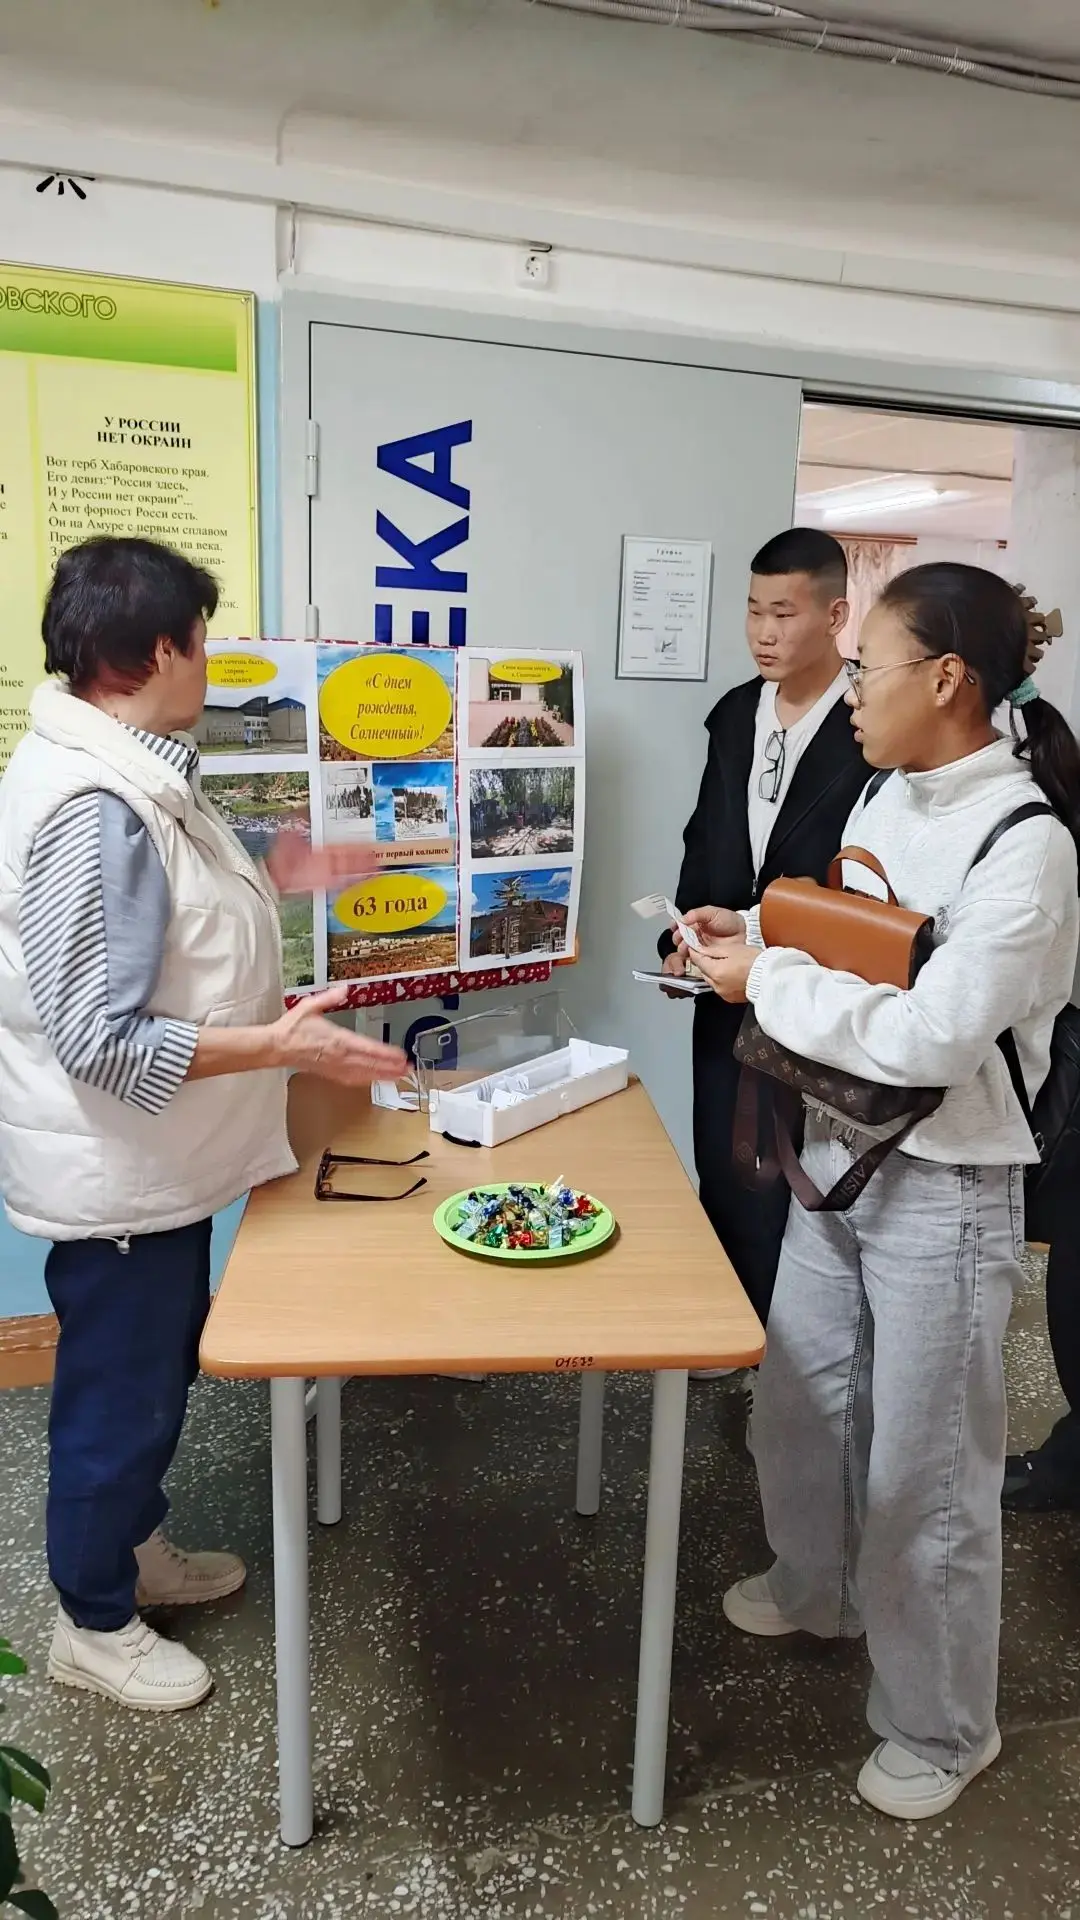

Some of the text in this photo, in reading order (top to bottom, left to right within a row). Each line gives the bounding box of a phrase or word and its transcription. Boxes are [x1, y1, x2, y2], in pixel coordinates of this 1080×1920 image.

[104, 416, 181, 433] У РОССИИ
[97, 431, 192, 449] НЕТ ОКРАИН
[45, 455, 210, 478] Вот герб Хабаровского края.
[47, 472, 67, 483] Его
[47, 486, 57, 497] И
[61, 489, 68, 500] у
[71, 487, 112, 500] России
[116, 492, 134, 502] нет
[48, 502, 58, 512] А
[62, 504, 80, 513] вот
[84, 504, 131, 517] форпост
[48, 516, 66, 528] Он
[70, 519, 83, 529] на
[86, 519, 124, 534] Амуре
[137, 523, 179, 537] первым
[183, 527, 228, 538] сплавом
[180, 541, 194, 550] на
[365, 672, 412, 690] «С днем
[357, 700, 417, 718] рожденья,
[350, 723, 425, 741] Солнечный»!
[386, 848, 414, 860] первый
[415, 847, 450, 857] колышек
[353, 896, 428, 917] 63 года
